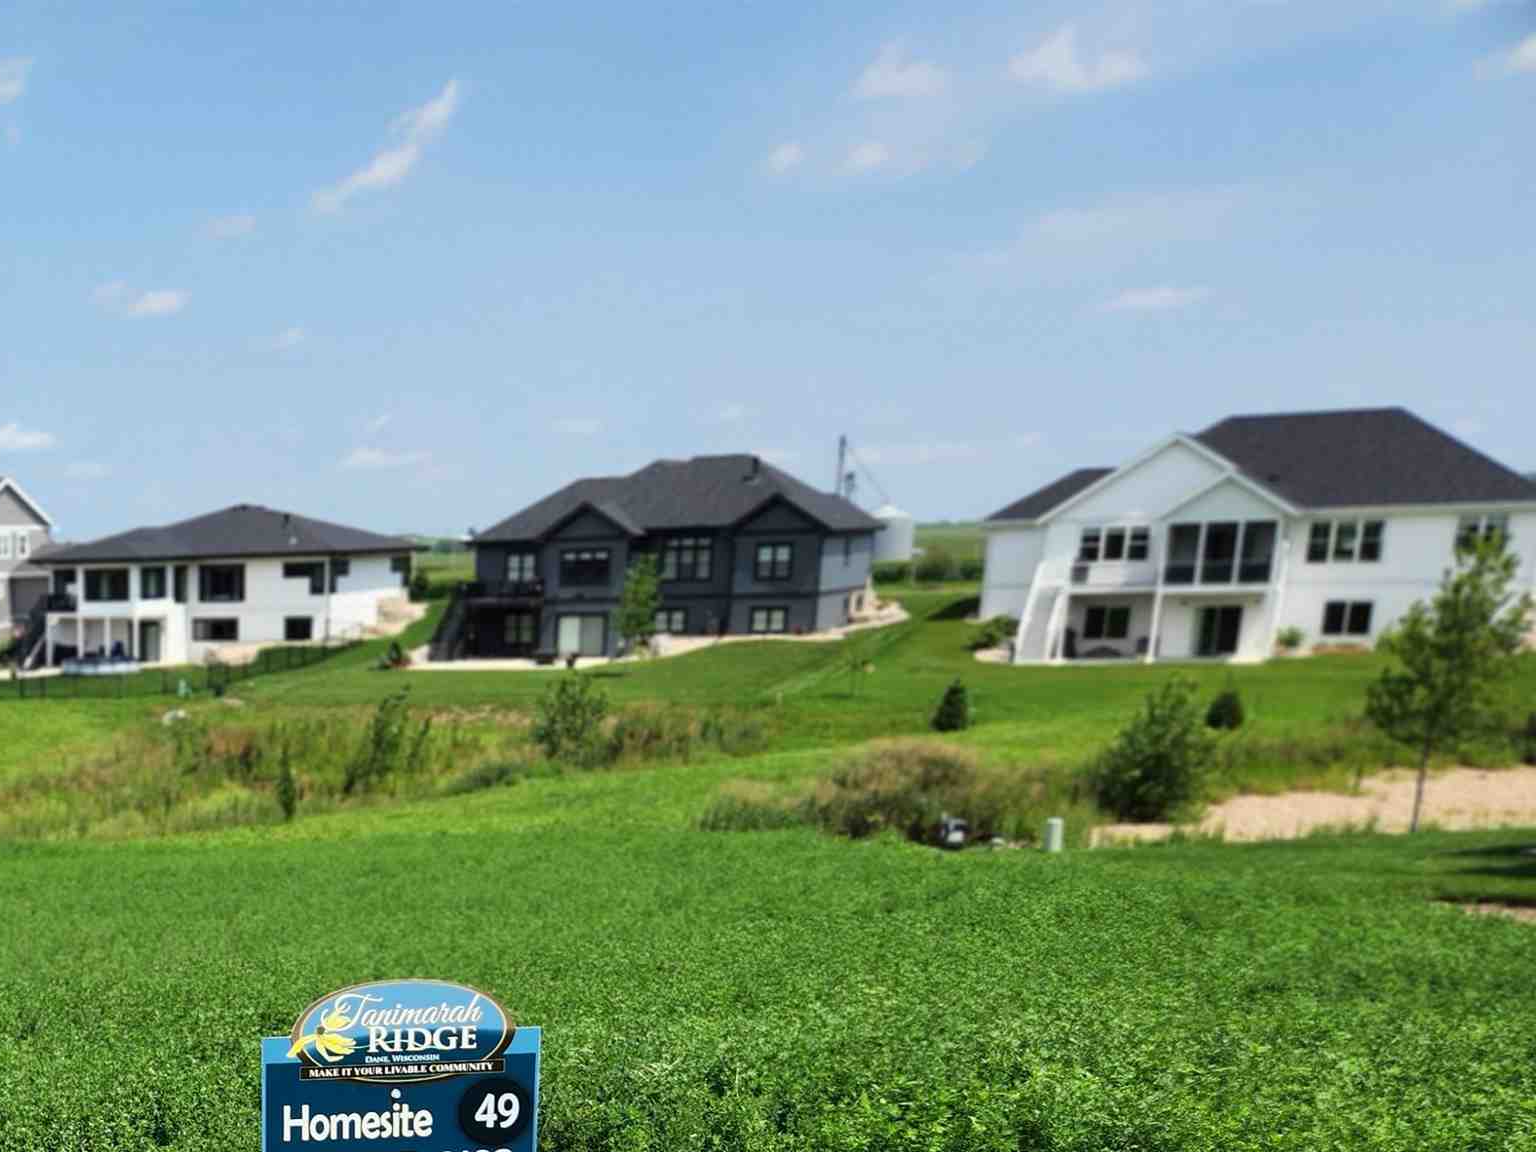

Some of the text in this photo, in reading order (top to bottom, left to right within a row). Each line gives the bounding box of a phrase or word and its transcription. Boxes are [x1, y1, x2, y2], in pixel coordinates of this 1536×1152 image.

[321, 993, 482, 1031] Tanimarah
[368, 1026, 477, 1052] RIDGE
[309, 1062, 494, 1077] MAKE IT YOUR LIVABLE COMMUNITY
[282, 1092, 521, 1142] Homesite 49
